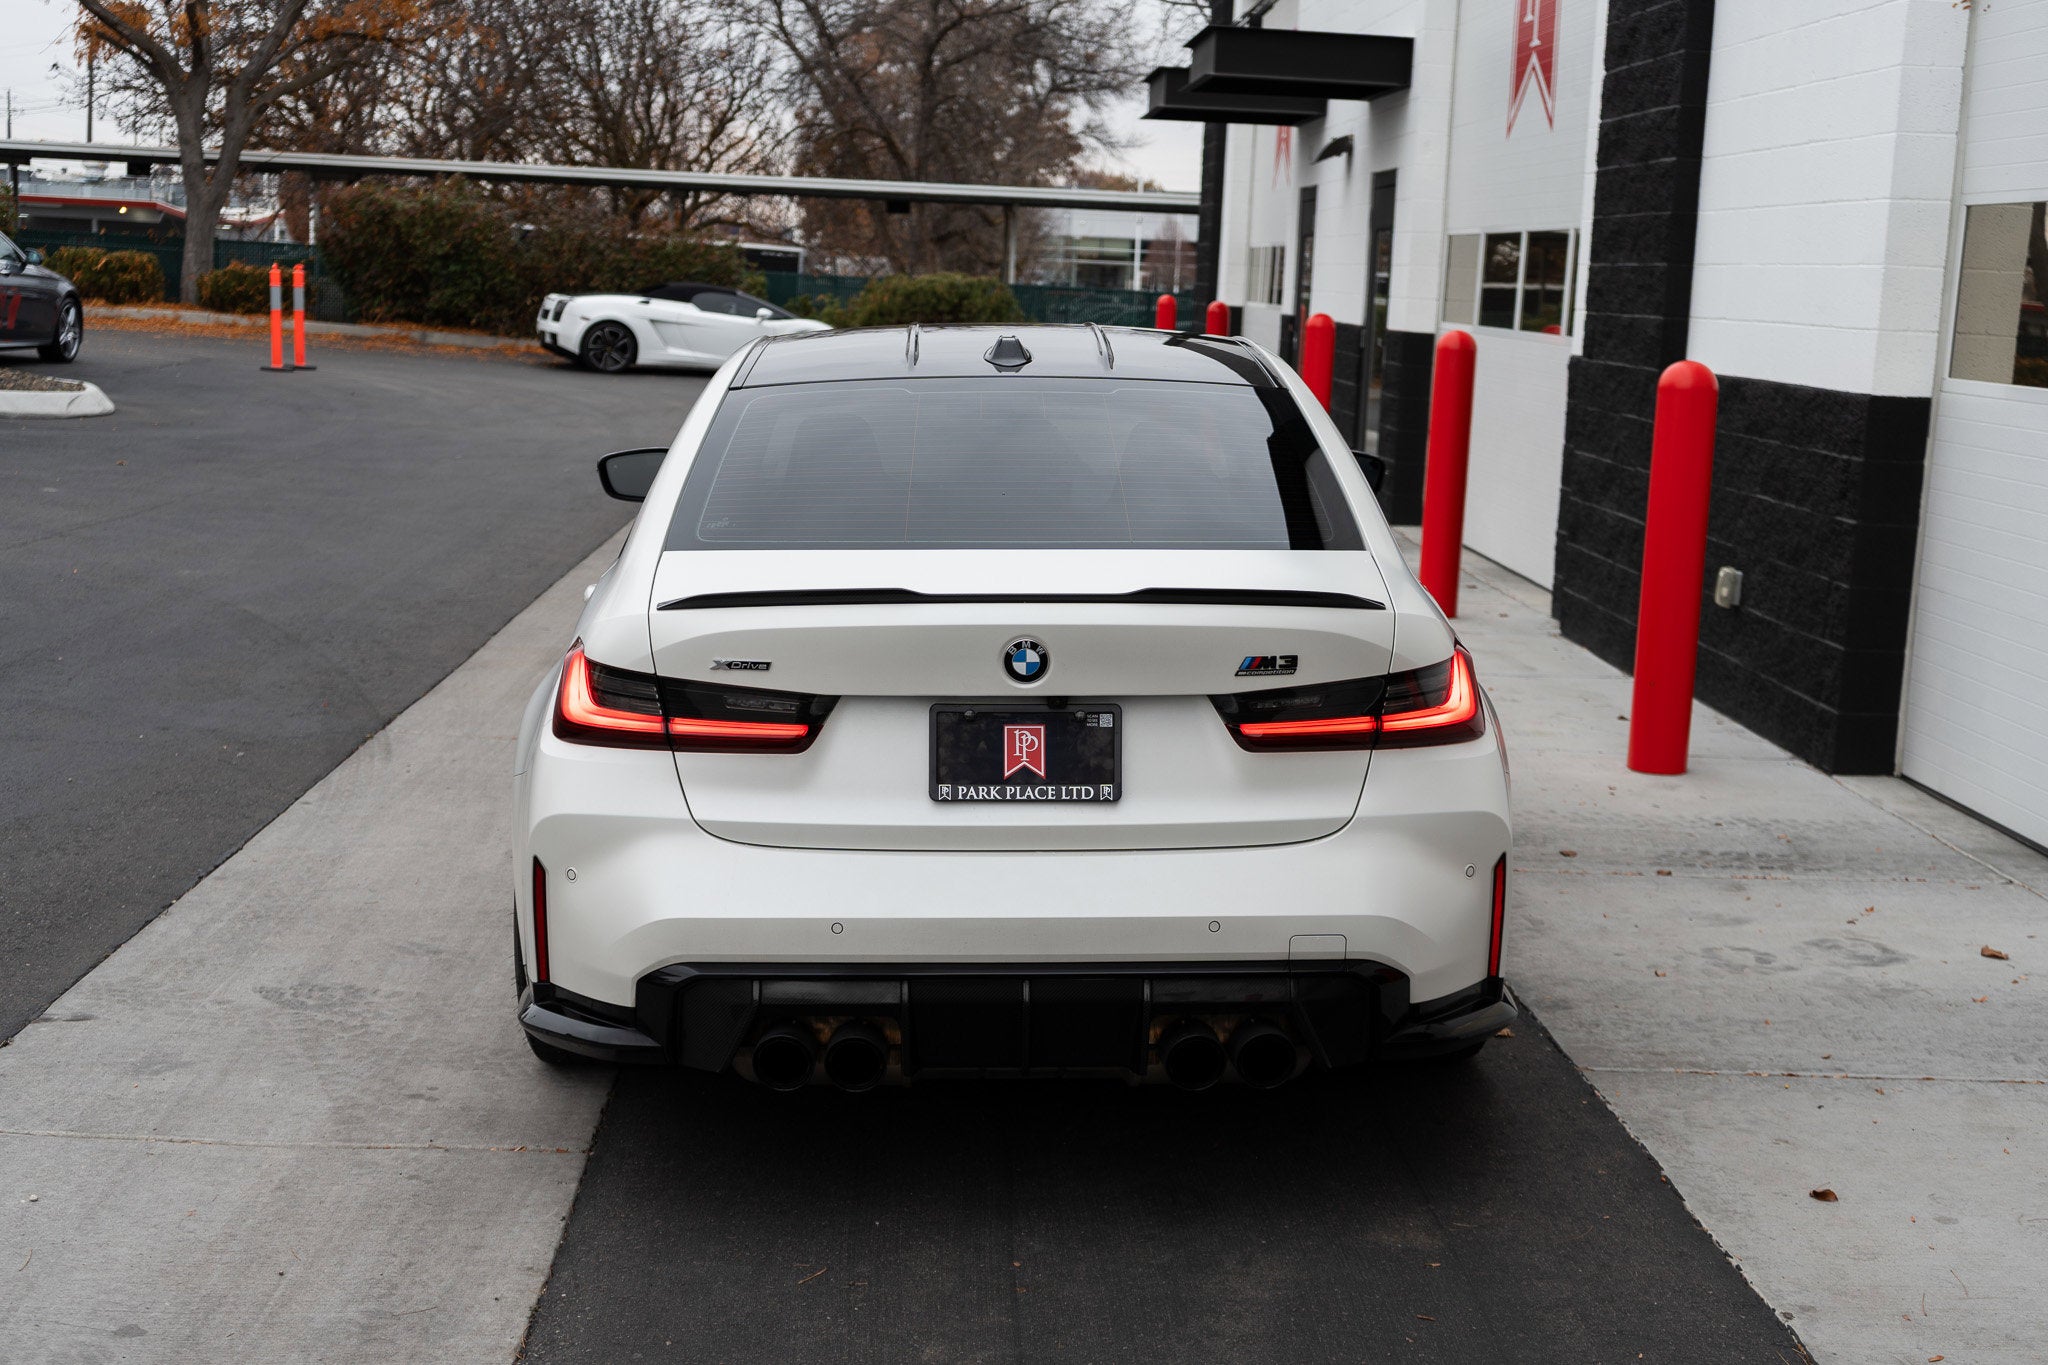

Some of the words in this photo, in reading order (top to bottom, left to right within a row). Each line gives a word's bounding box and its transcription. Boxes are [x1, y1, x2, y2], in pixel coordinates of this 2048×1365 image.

[1008, 640, 1045, 655] BMW
[1244, 655, 1298, 669] M3
[957, 785, 1003, 800] PARK
[1005, 785, 1056, 800] PLACE
[1061, 785, 1095, 800] LTD
